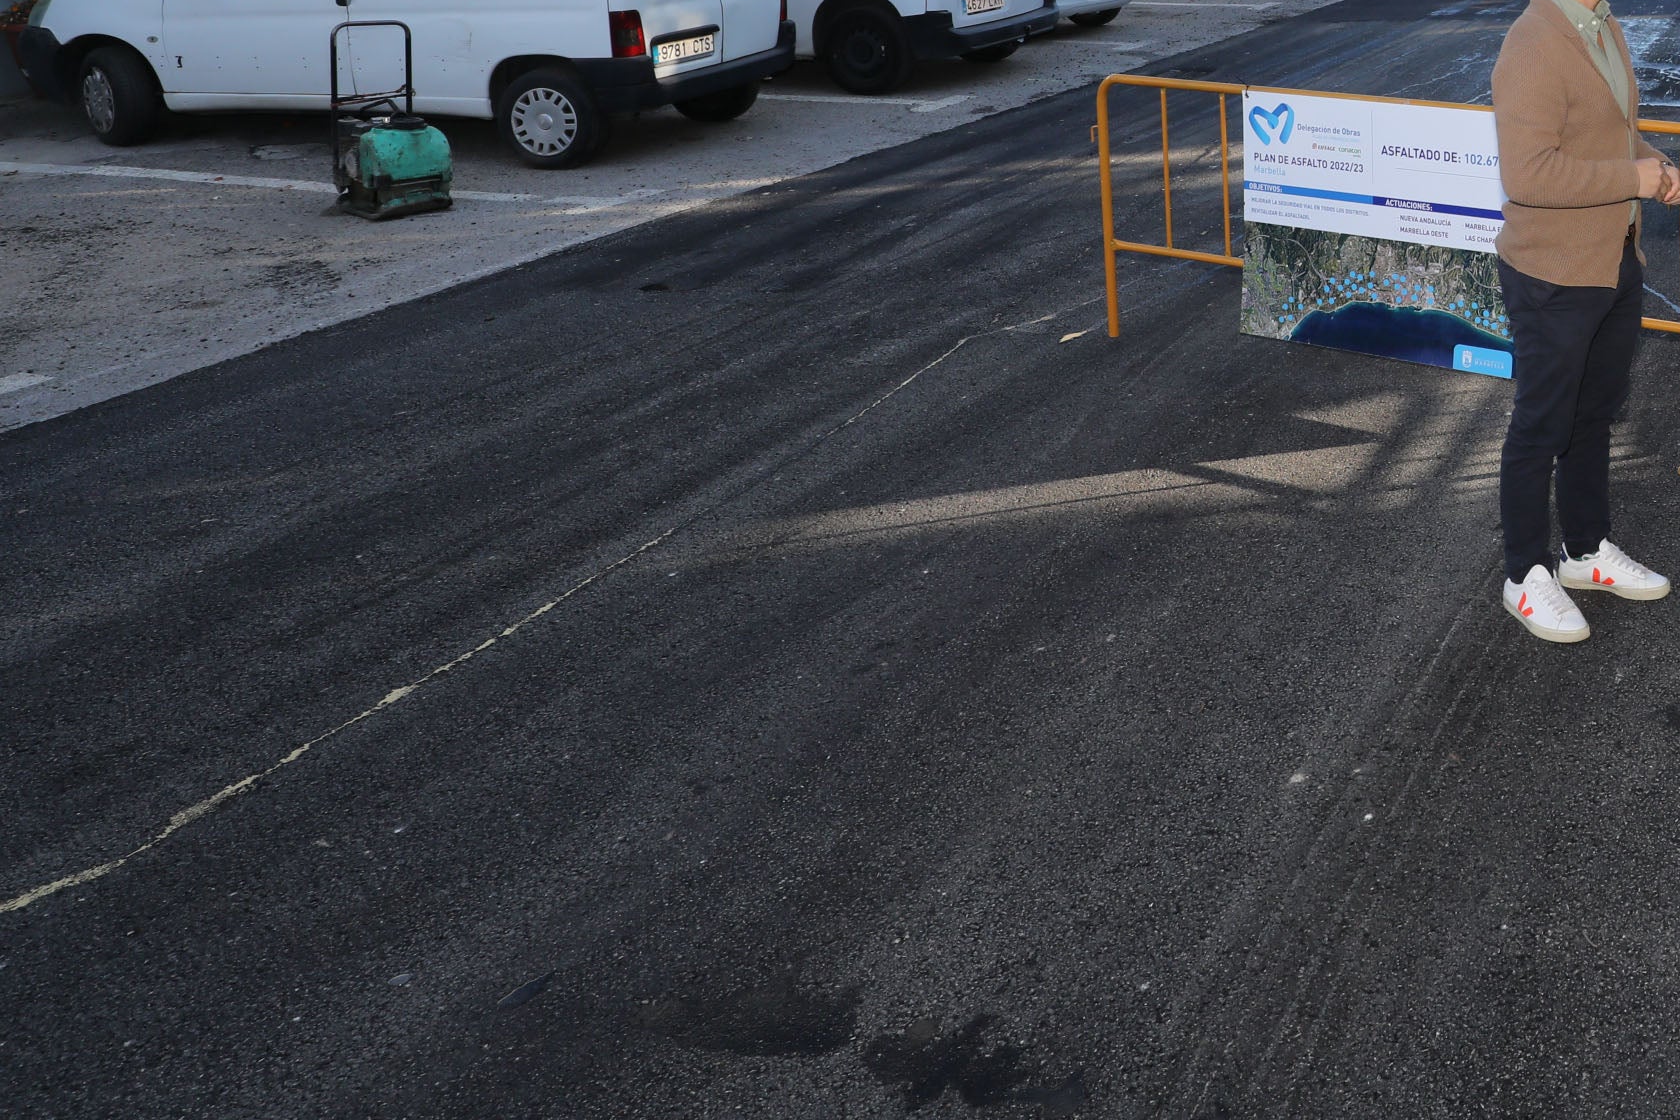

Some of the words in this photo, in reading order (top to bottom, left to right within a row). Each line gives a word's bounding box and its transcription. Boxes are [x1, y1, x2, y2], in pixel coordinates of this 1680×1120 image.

[661, 43, 686, 60] 9781
[693, 37, 711, 53] CTS
[1332, 126, 1340, 134] de
[1342, 127, 1360, 136] Obras
[1381, 145, 1440, 161] ASFALTADO
[1444, 152, 1461, 163] DE:
[1465, 154, 1499, 167] 102.67
[1254, 152, 1275, 164] PLAN
[1278, 155, 1288, 164] DE
[1291, 157, 1328, 169] ASFALTO
[1330, 161, 1364, 173] 2022/23
[1254, 165, 1286, 176] Marbella
[1248, 182, 1282, 193] OBJETIVOS:
[1386, 199, 1432, 211] ACTUACIONES:
[1420, 217, 1451, 226] ANDALUCÍA
[1400, 227, 1430, 236] MARBELLA
[1465, 223, 1496, 232] MARBELLA
